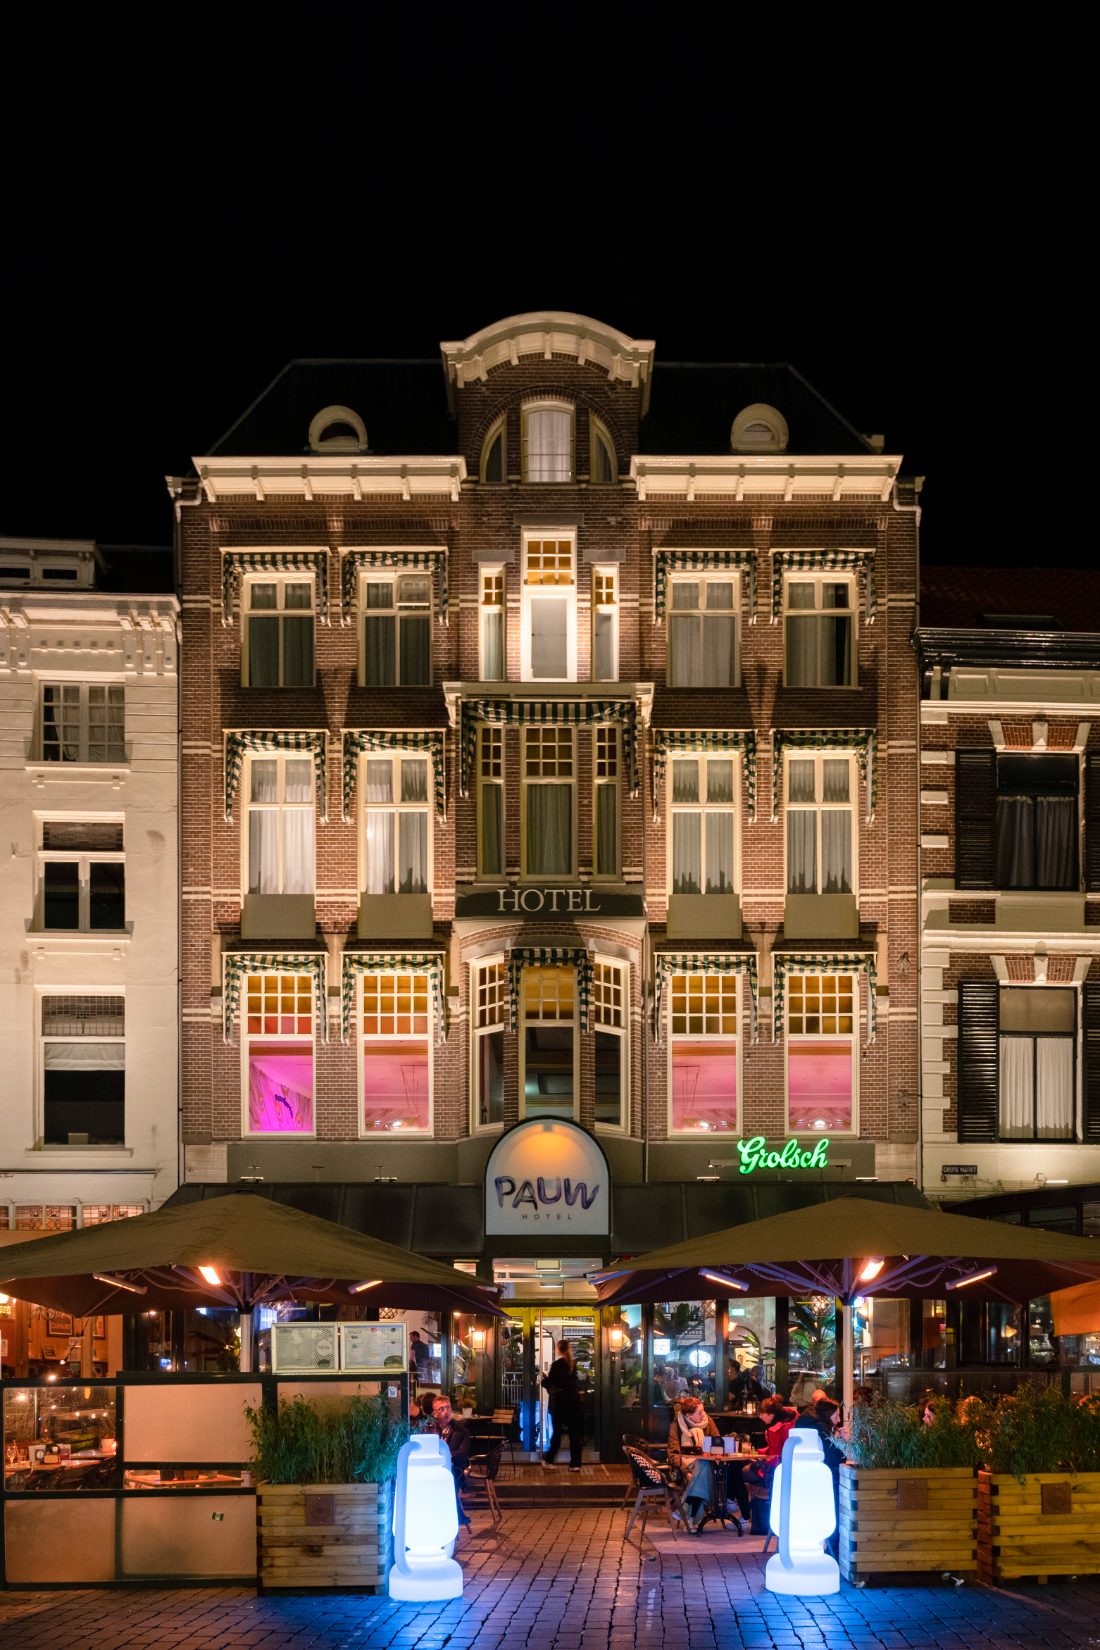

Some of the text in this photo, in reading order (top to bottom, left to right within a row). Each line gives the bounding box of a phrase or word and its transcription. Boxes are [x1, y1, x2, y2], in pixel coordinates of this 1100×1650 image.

[496, 889, 601, 912] HOTEL
[737, 1136, 830, 1174] Grolsch
[494, 1175, 600, 1211] PAUW
